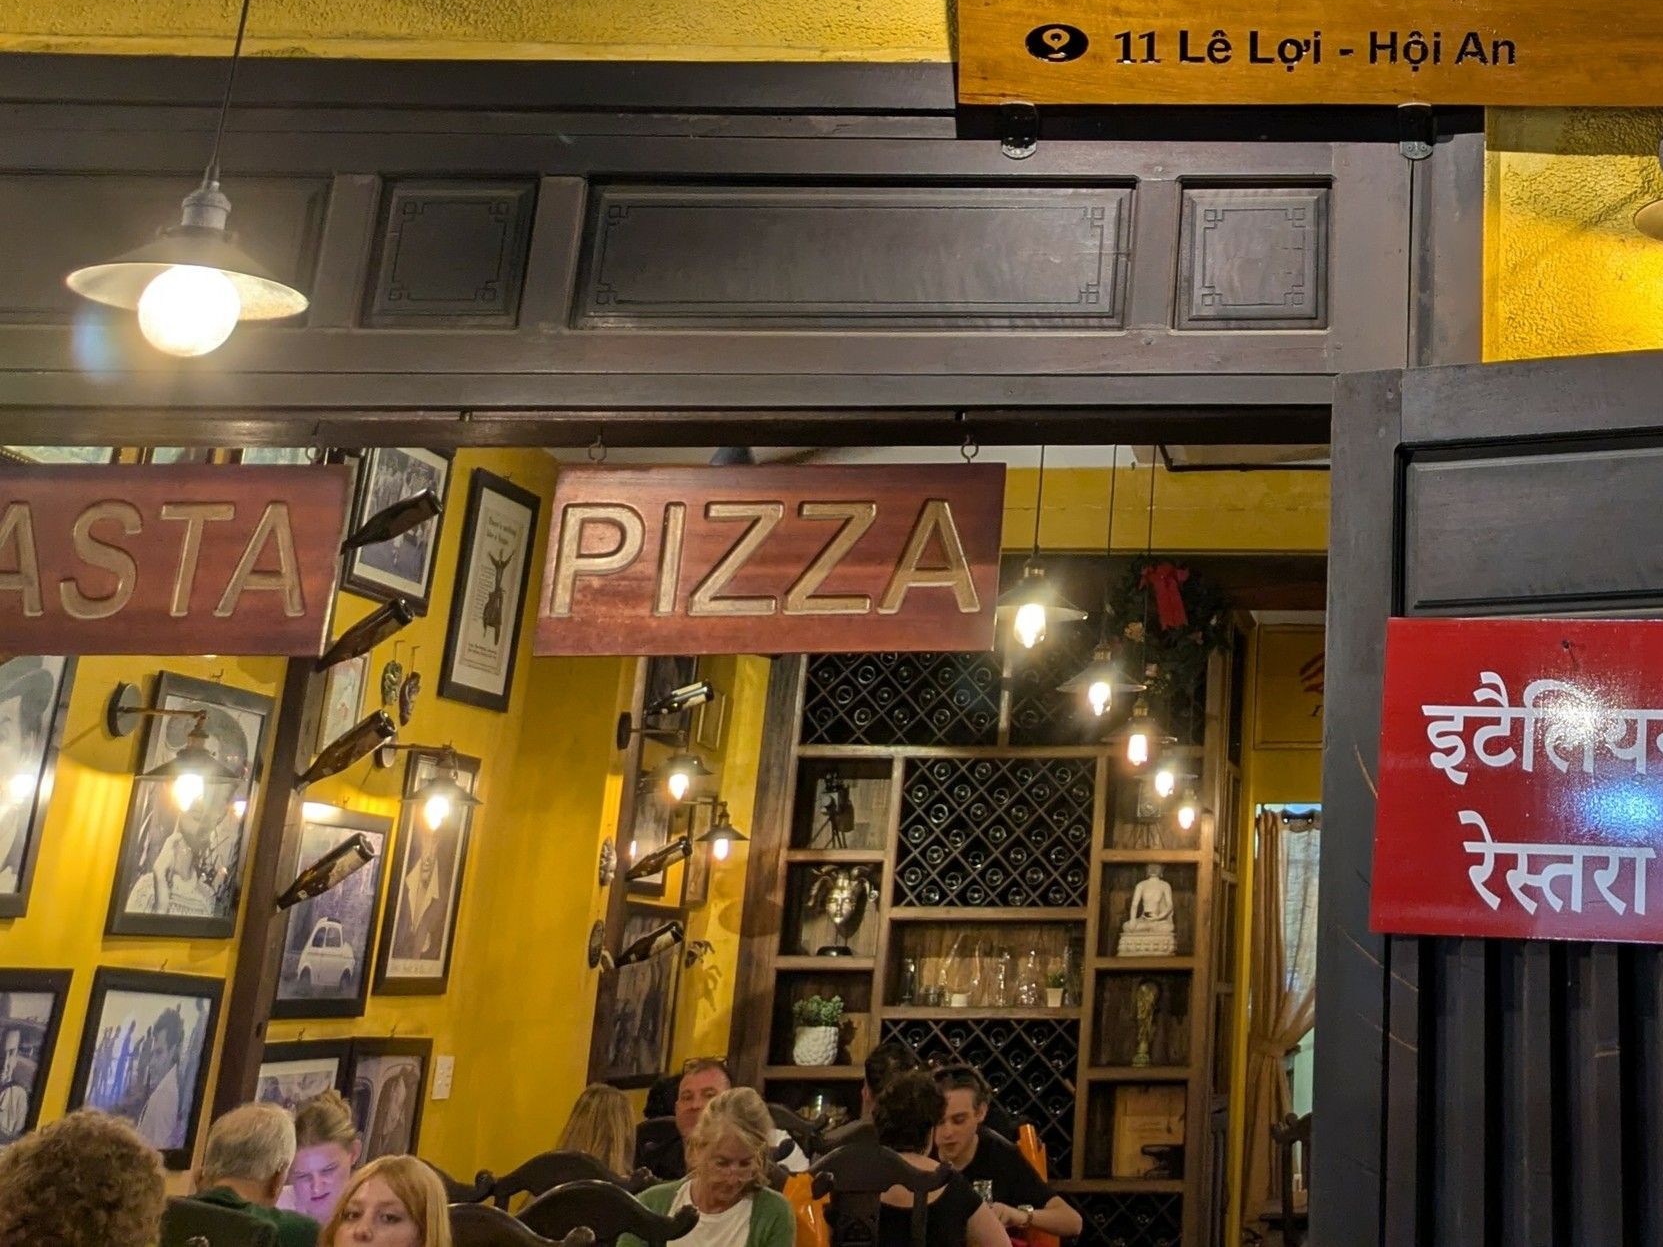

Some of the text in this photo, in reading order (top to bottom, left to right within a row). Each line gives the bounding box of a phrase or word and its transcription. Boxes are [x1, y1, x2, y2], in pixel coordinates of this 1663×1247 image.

[1114, 30, 1161, 65] 11
[1178, 29, 1233, 65] Lê
[1248, 30, 1321, 73] Lợi
[1368, 30, 1442, 72] Hội
[1455, 31, 1517, 66] An
[548, 497, 983, 619] PIZZA
